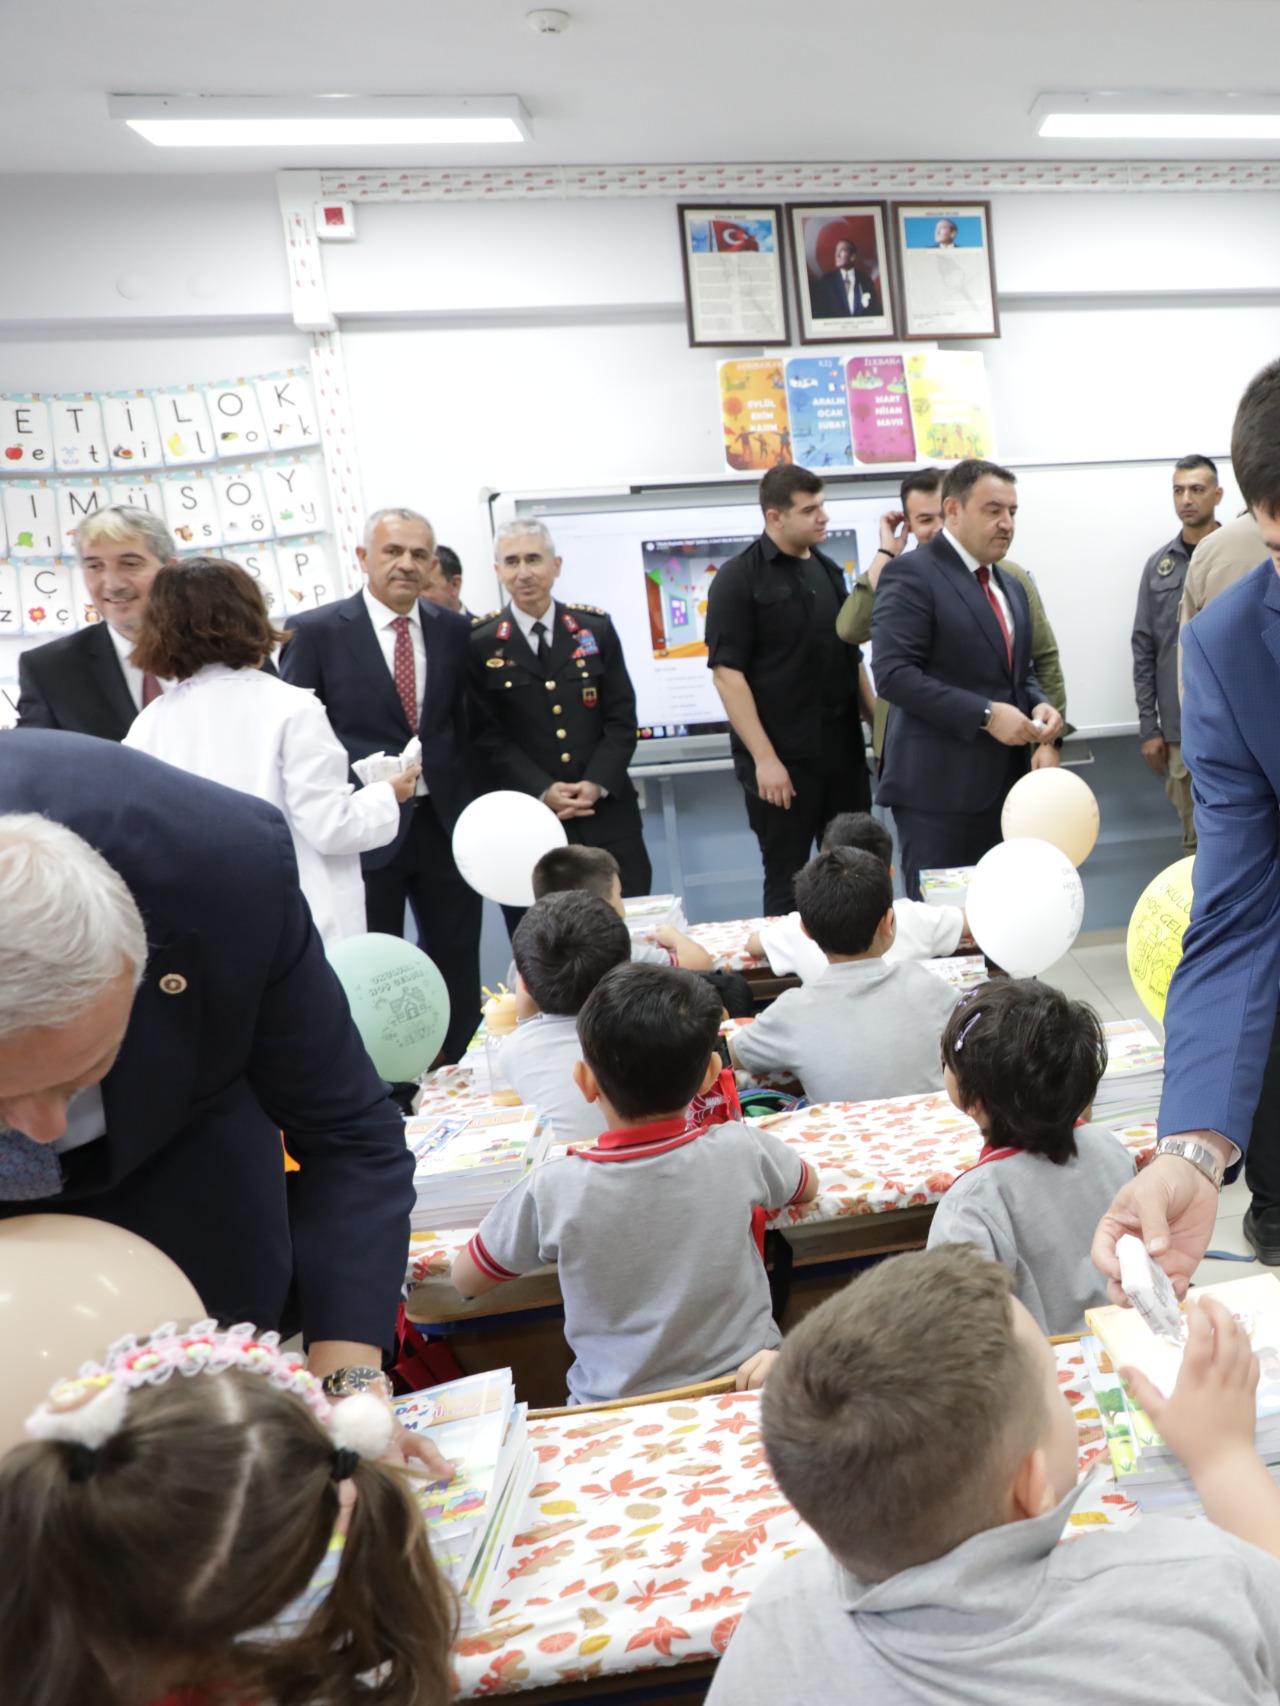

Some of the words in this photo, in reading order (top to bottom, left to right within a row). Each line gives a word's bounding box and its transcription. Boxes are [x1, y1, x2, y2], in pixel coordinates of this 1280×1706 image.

[16, 409, 33, 434] E
[66, 408, 83, 433] T
[125, 401, 134, 432] İ
[172, 400, 192, 423] L
[218, 392, 243, 416] O
[274, 383, 295, 408] K
[817, 408, 844, 418] OCAK
[875, 395, 901, 404] MART
[69, 491, 99, 515] M
[180, 486, 198, 510] S
[277, 468, 296, 492] Y
[34, 570, 58, 599] Ç
[294, 552, 309, 577] P
